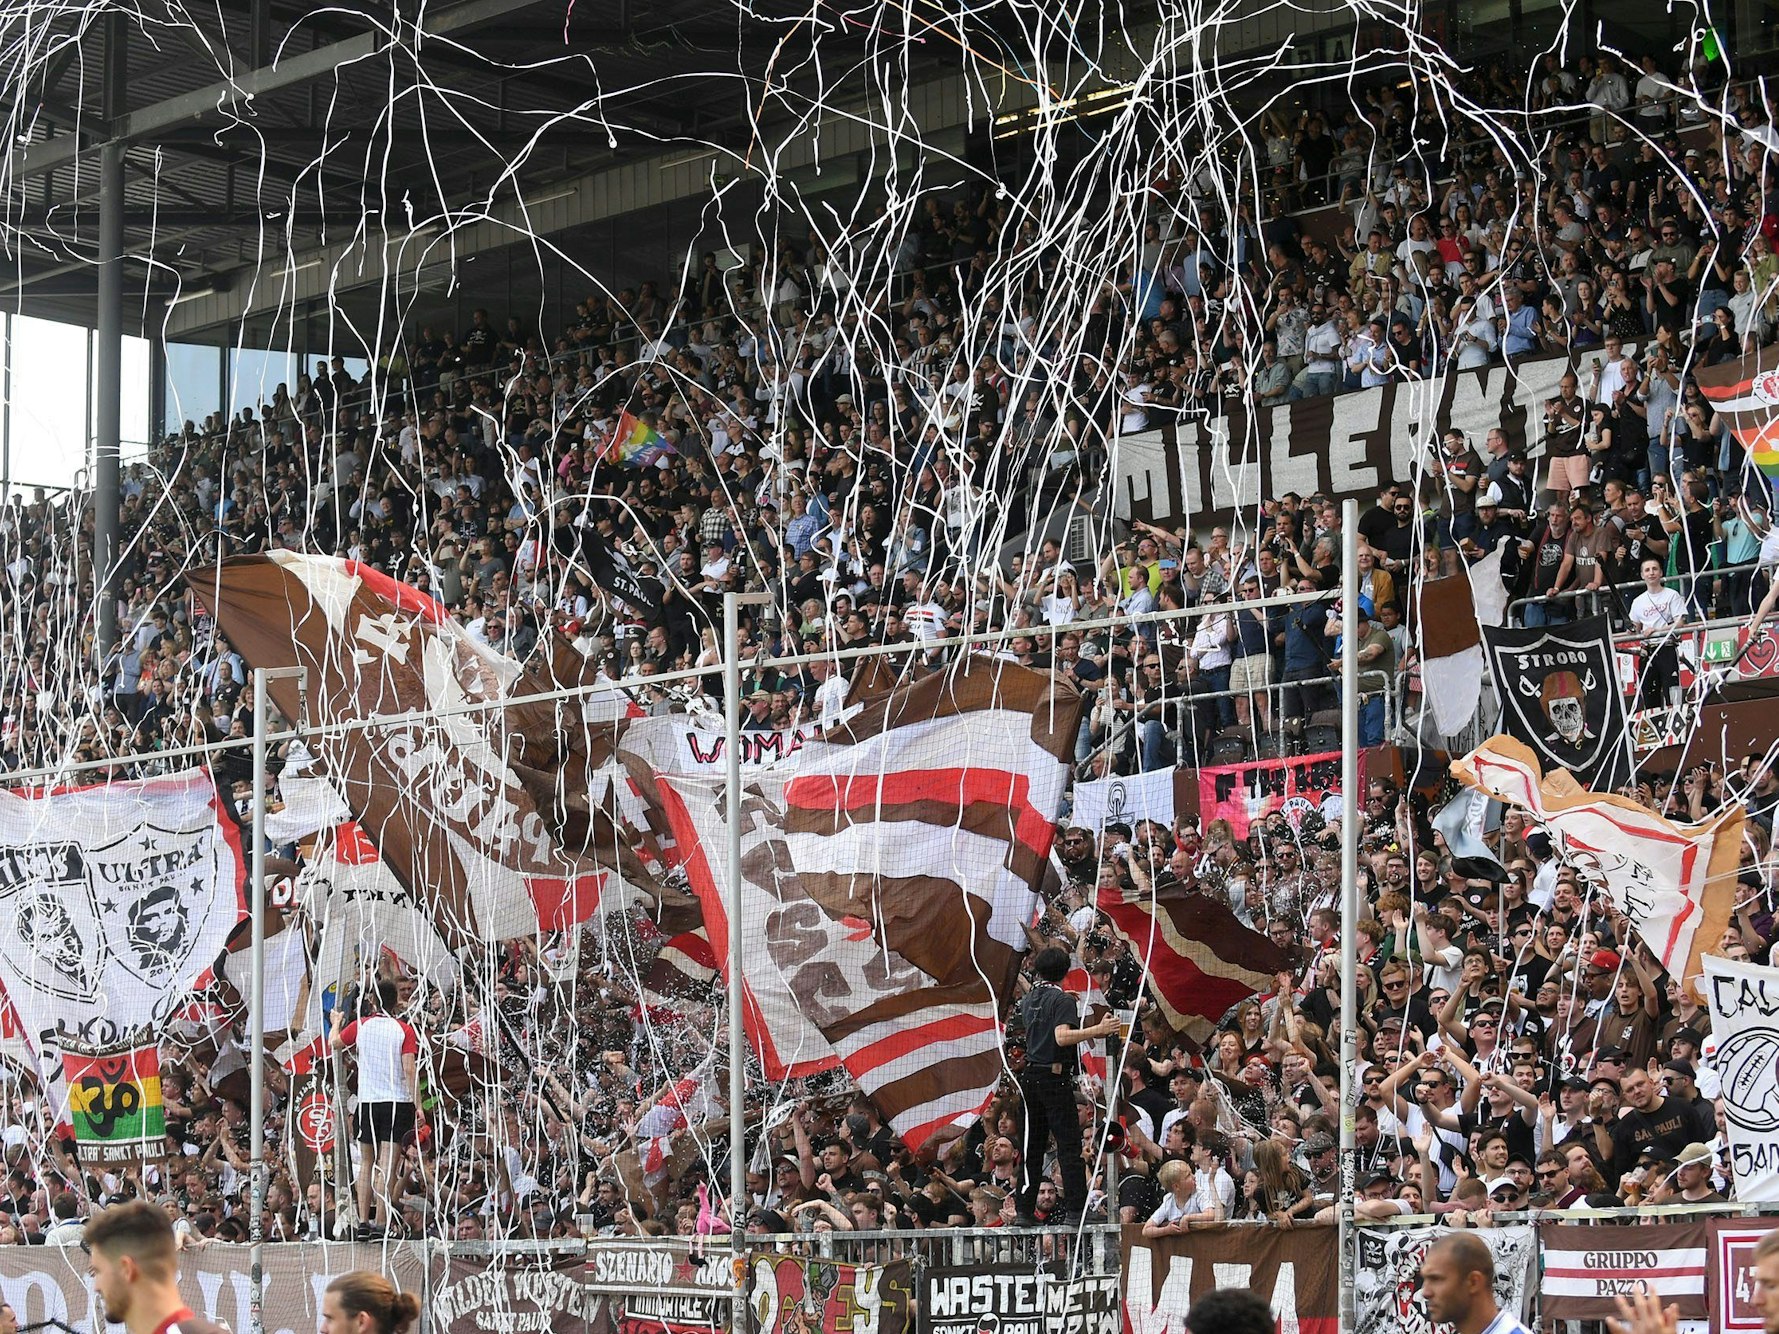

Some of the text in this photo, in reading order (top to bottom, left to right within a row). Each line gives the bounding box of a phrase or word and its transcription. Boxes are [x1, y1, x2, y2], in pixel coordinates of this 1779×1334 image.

[1514, 651, 1588, 670] STROBO
[103, 1145, 132, 1162] SANKT
[134, 1141, 166, 1160] PAULI
[595, 1250, 673, 1285] SZENARIO
[1583, 1251, 1658, 1269] GRUPPO
[1596, 1278, 1648, 1298] PAZZO
